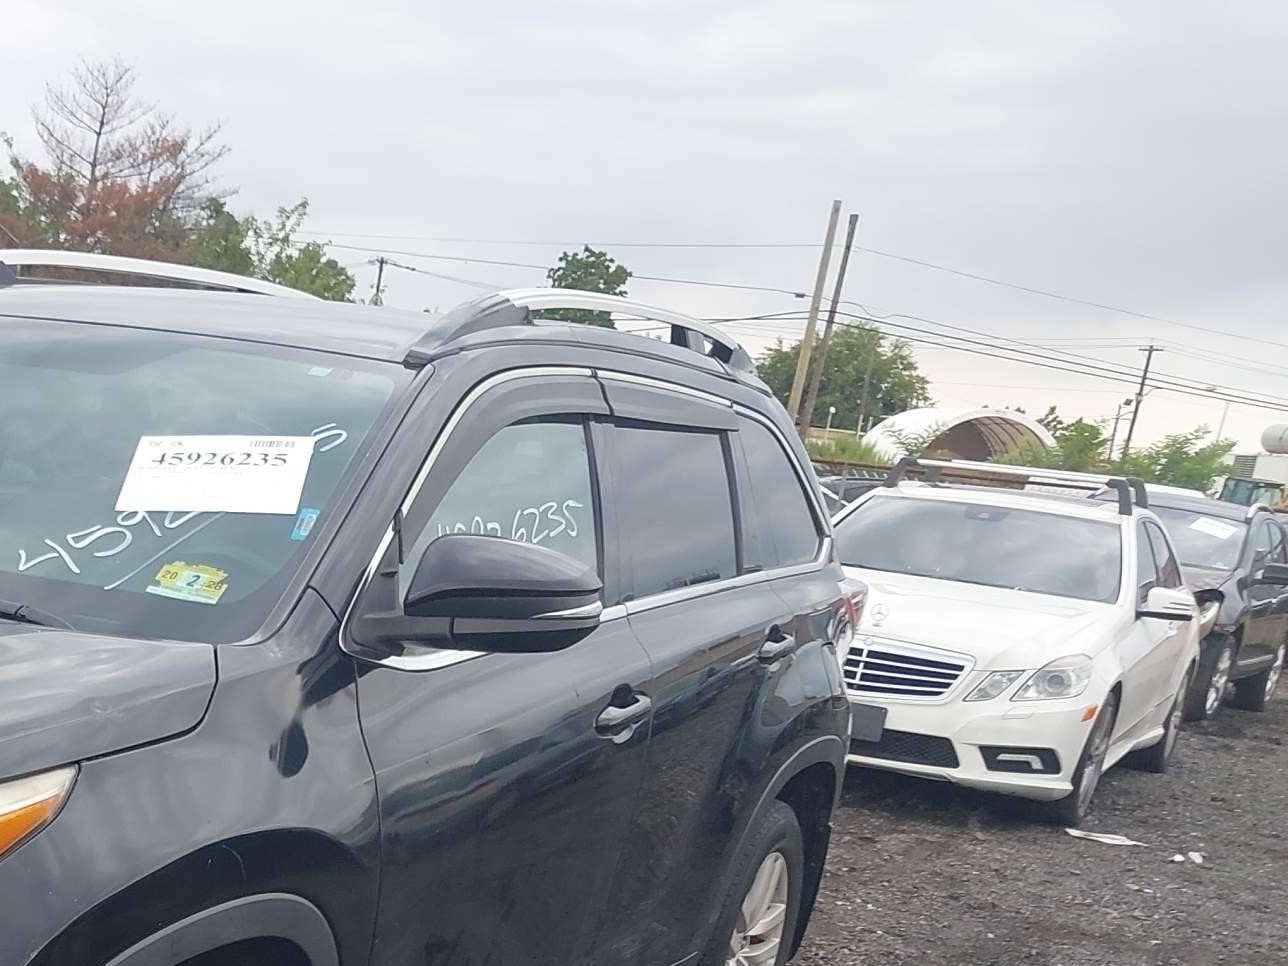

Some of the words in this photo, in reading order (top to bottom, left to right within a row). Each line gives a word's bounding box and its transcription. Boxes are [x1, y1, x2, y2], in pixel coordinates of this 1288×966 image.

[151, 452, 289, 467] 45926235
[437, 500, 585, 544] 6235
[161, 570, 178, 580] 20
[186, 575, 201, 587] 2
